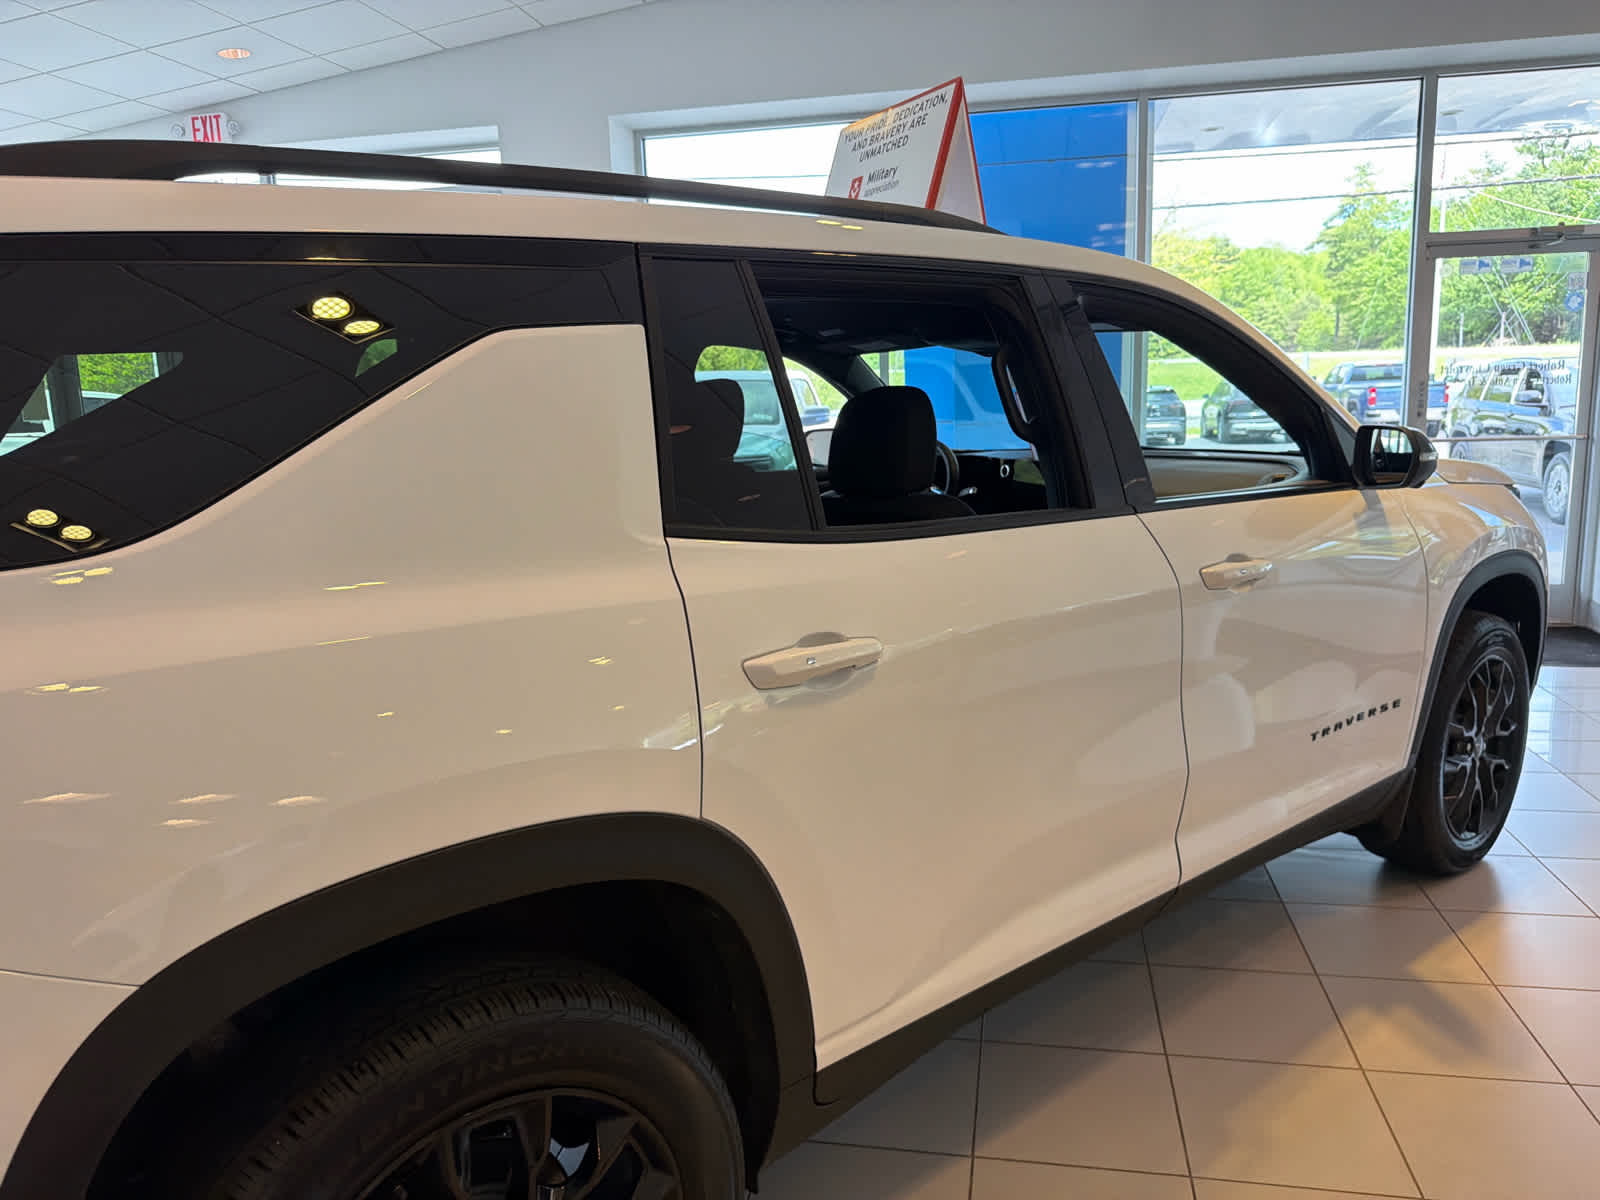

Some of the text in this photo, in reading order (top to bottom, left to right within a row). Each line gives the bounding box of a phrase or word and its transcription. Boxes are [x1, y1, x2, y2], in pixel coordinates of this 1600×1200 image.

[191, 114, 222, 143] EXIT
[843, 127, 864, 144] YOUR
[893, 92, 948, 122] DEDICATION,
[852, 113, 929, 152] AND BRAVERY ARE
[859, 135, 909, 162] UNMATCHED
[866, 166, 898, 184] Military
[1310, 698, 1401, 742] TRAVERSE
